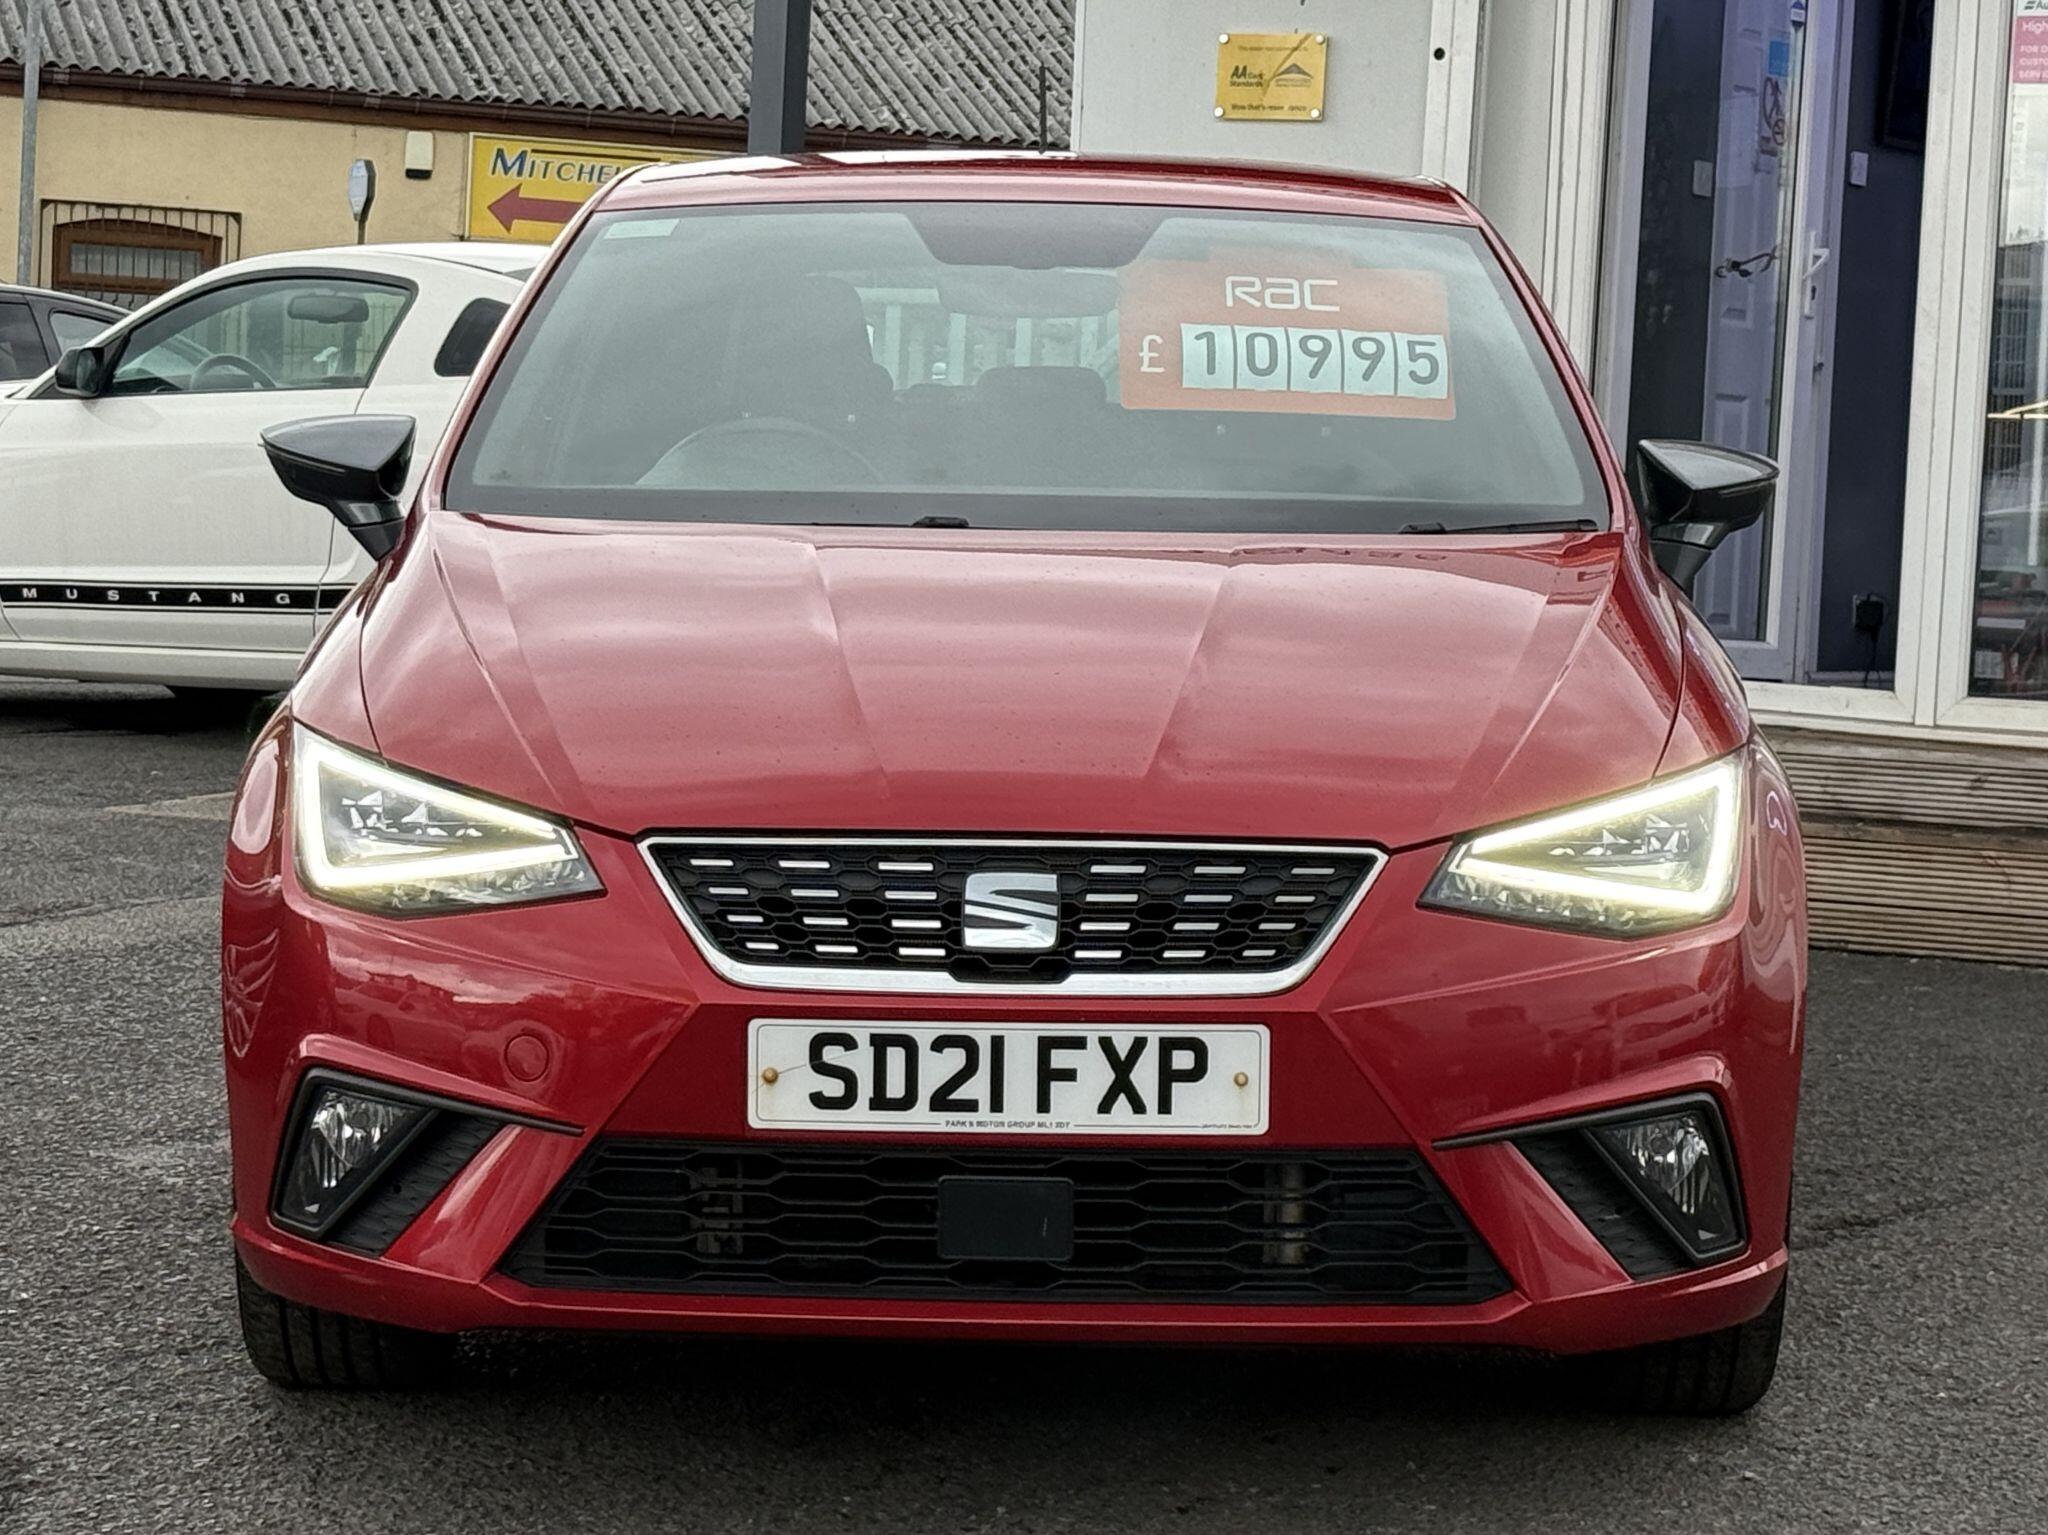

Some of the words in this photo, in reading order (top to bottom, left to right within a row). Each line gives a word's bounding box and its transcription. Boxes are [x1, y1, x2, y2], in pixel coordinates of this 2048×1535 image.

[1193, 330, 1440, 386] 10995
[22, 587, 291, 606] MUSTANG
[808, 1032, 1005, 1113] SD21
[1036, 1035, 1209, 1115] FXP
[1006, 1120, 1035, 1129] GROUP
